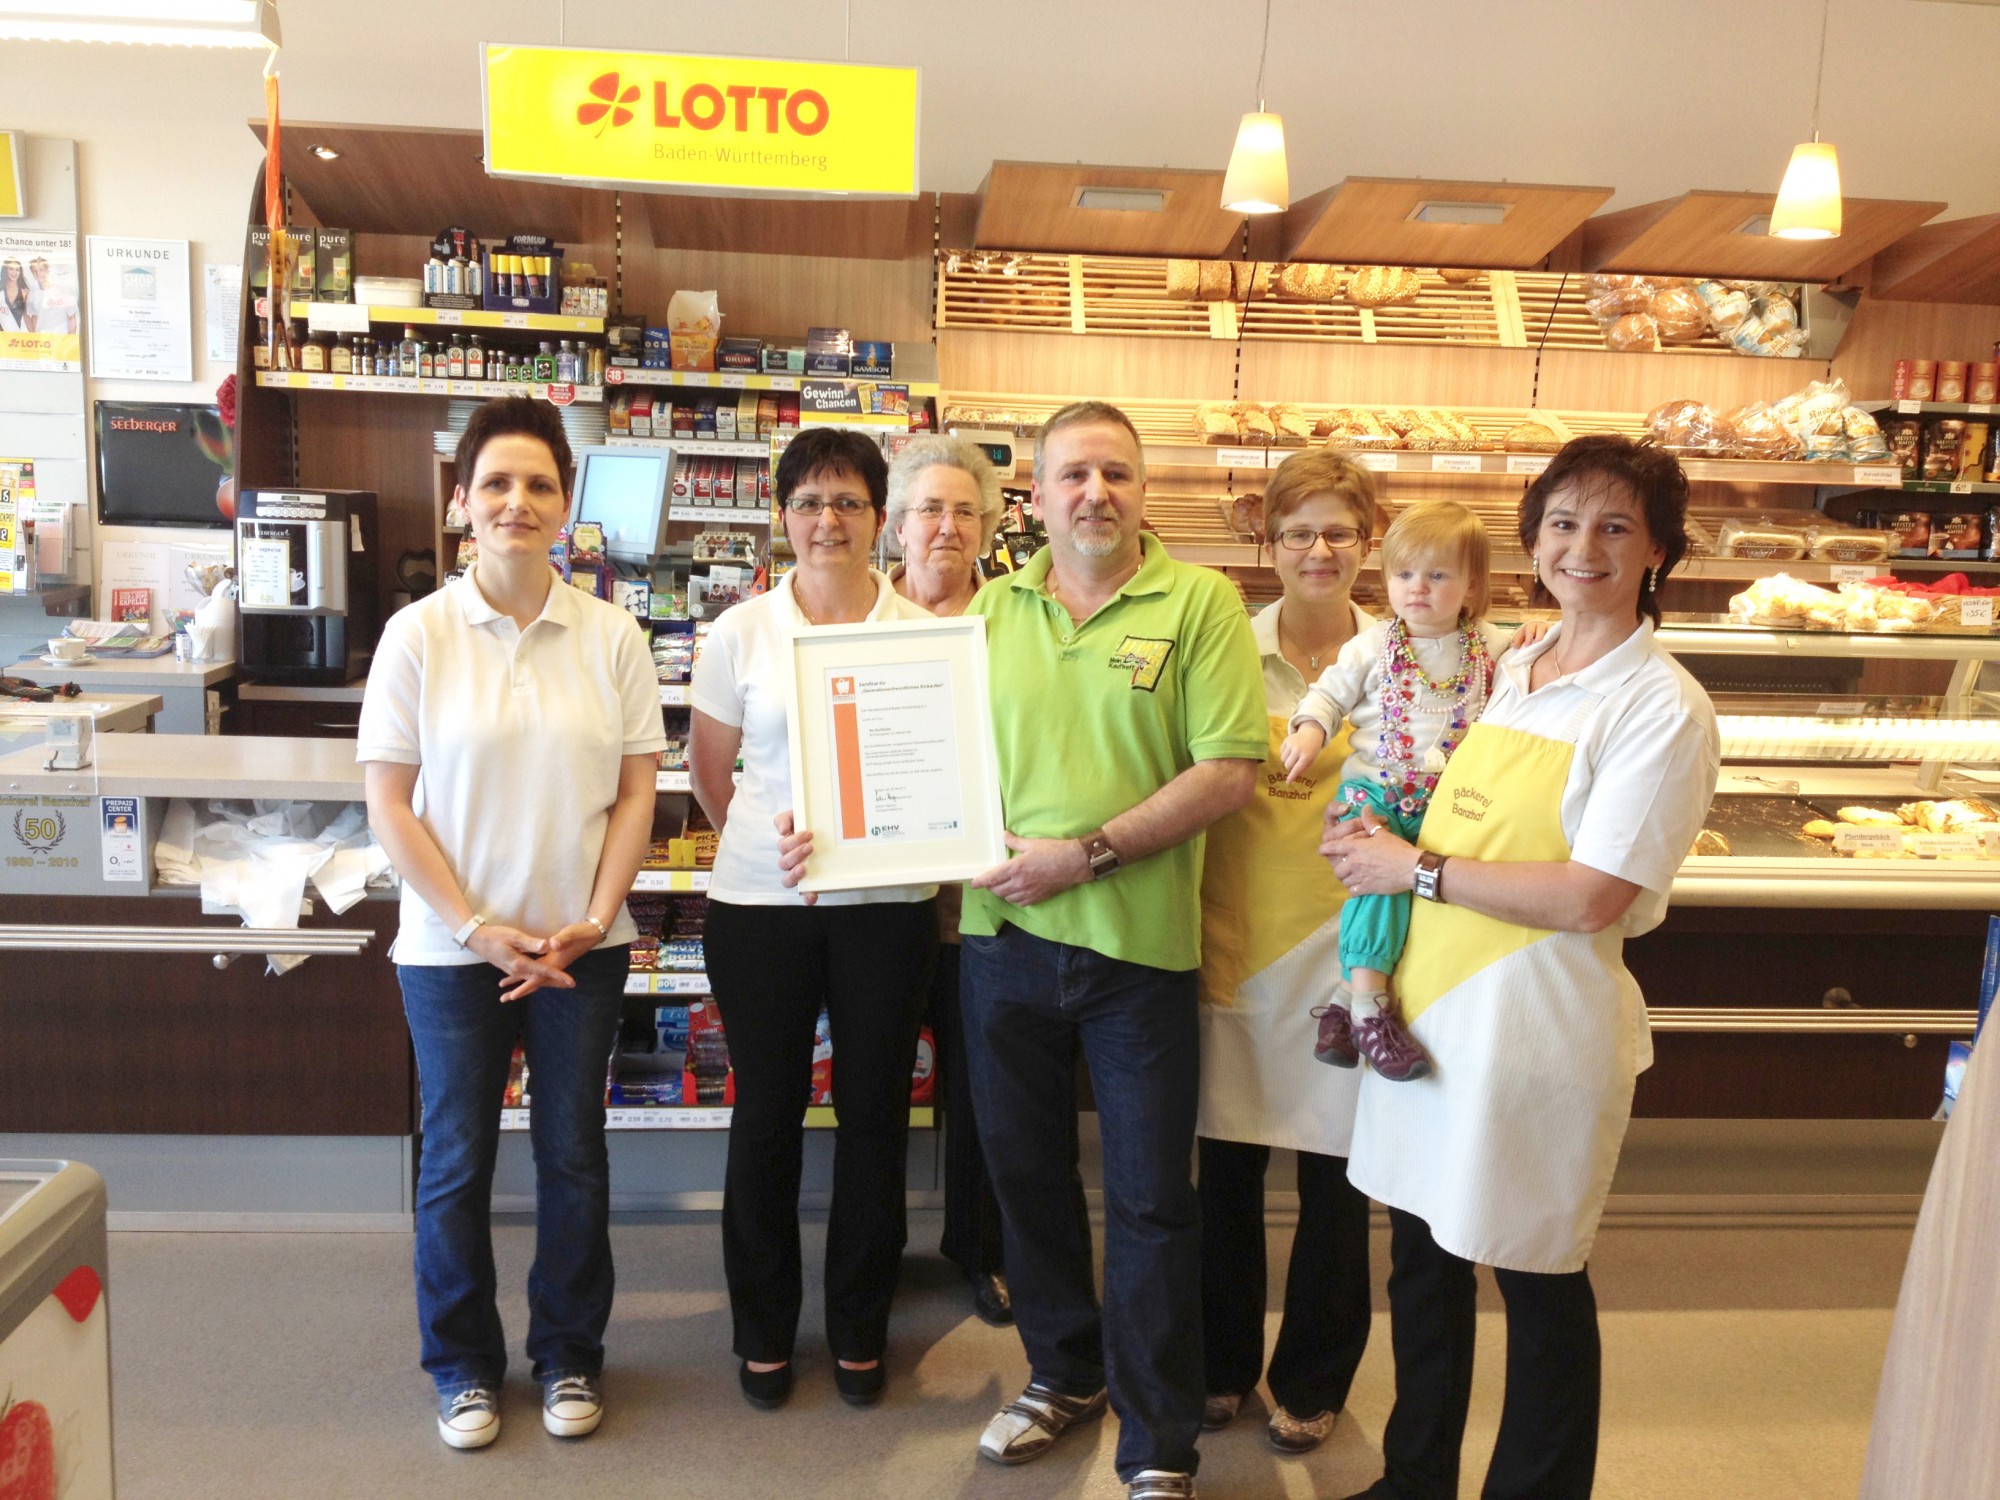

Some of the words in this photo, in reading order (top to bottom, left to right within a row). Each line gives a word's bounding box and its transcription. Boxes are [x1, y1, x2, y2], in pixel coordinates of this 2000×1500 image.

[653, 81, 830, 136] LOTTO
[653, 143, 828, 171] Baden-Württemberg
[5, 237, 33, 247] Chance
[35, 239, 57, 247] unter
[59, 240, 72, 248] 18!
[319, 235, 347, 248] pure
[107, 248, 170, 260] URKUNDE
[123, 274, 154, 288] SHOP
[21, 339, 51, 348] LOTO
[853, 365, 889, 373] SAMSON
[803, 386, 844, 399] Gewinn
[816, 398, 857, 409] Chancen
[110, 418, 177, 433] SEEBERGER
[1267, 772, 1316, 789] Bäcerei
[1268, 787, 1313, 800] Banzhaf
[1453, 787, 1493, 809] Bäckerei
[1451, 803, 1487, 822] Banzhaf
[25, 818, 56, 840] 50
[696, 833, 717, 841] PICK
[695, 844, 717, 852] PICK
[695, 1027, 718, 1035] HARIBO
